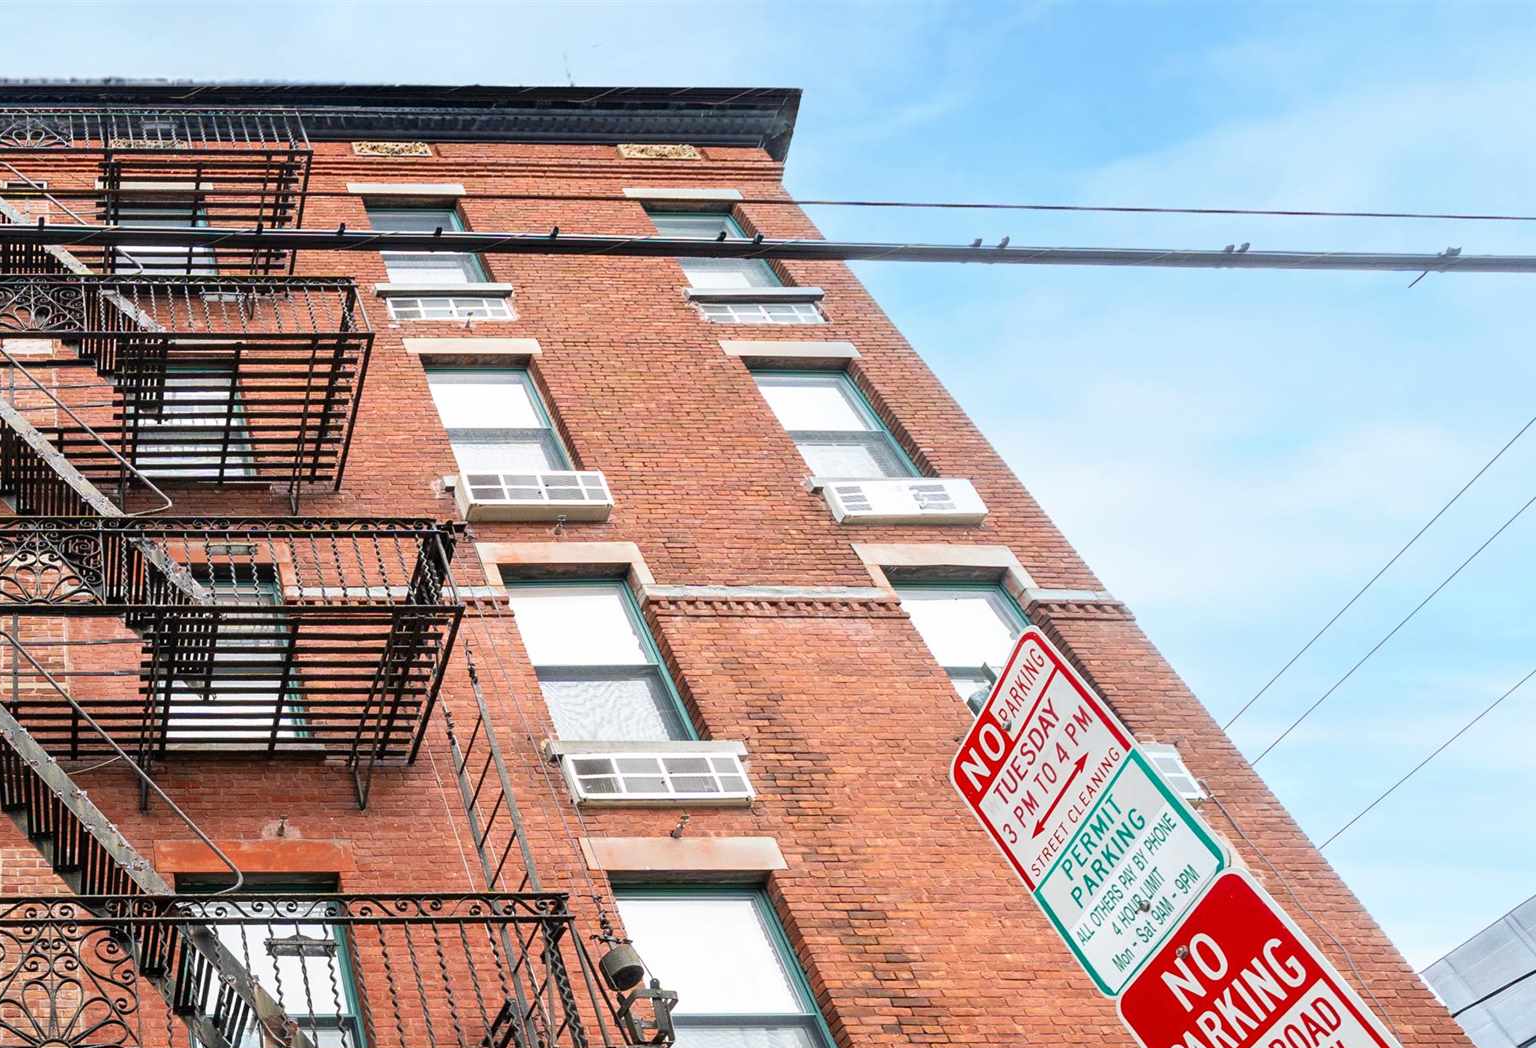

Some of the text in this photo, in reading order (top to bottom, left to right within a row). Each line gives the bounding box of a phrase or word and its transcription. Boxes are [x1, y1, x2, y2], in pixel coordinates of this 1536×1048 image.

[960, 648, 1045, 792] NO PARKING
[992, 697, 1060, 804] TUESDAY
[1003, 705, 1093, 844] 3 PM TO 4 PM
[1031, 747, 1120, 877] STREET CLEANING
[1061, 794, 1121, 881] PERMIT
[1070, 808, 1145, 908] PARKING
[1076, 812, 1177, 946] ALL OTHERS PAY BY PHONE
[1112, 866, 1165, 937] 4 HOUR LIMIT
[1112, 948, 1134, 972] Mon
[1136, 920, 1157, 943] Sat
[1151, 896, 1176, 925] 9AM
[1174, 864, 1201, 895] 9PM
[1160, 932, 1228, 1013] NO
